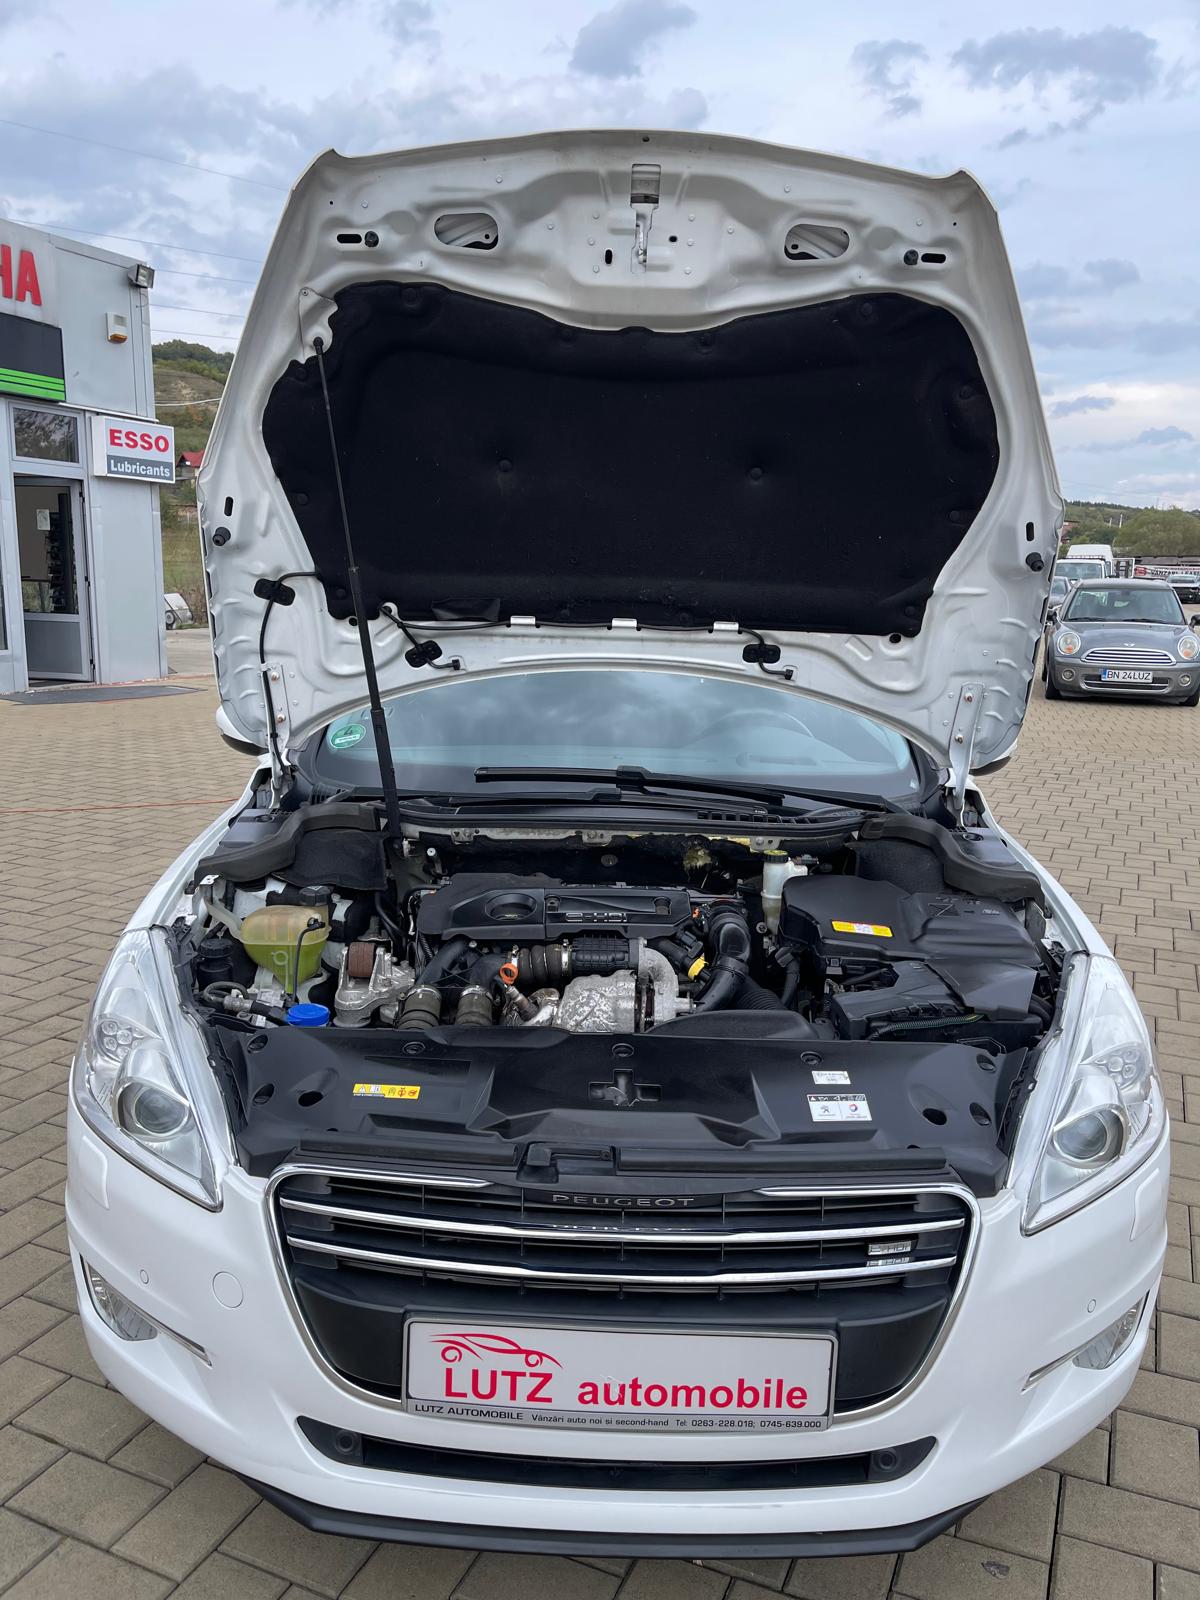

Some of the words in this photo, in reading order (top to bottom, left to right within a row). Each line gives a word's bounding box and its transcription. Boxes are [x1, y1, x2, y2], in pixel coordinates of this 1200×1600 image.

[109, 428, 169, 453] ESSO
[110, 459, 170, 477] Lubricants
[1107, 670, 1120, 679] BN
[552, 1194, 695, 1206] PEUGEOT
[445, 1368, 553, 1403] LUTZ
[577, 1376, 808, 1409] automobile
[414, 1404, 444, 1414] LUTZ
[447, 1407, 524, 1420] AUTOMOBILE
[615, 1418, 669, 1427] second-hand
